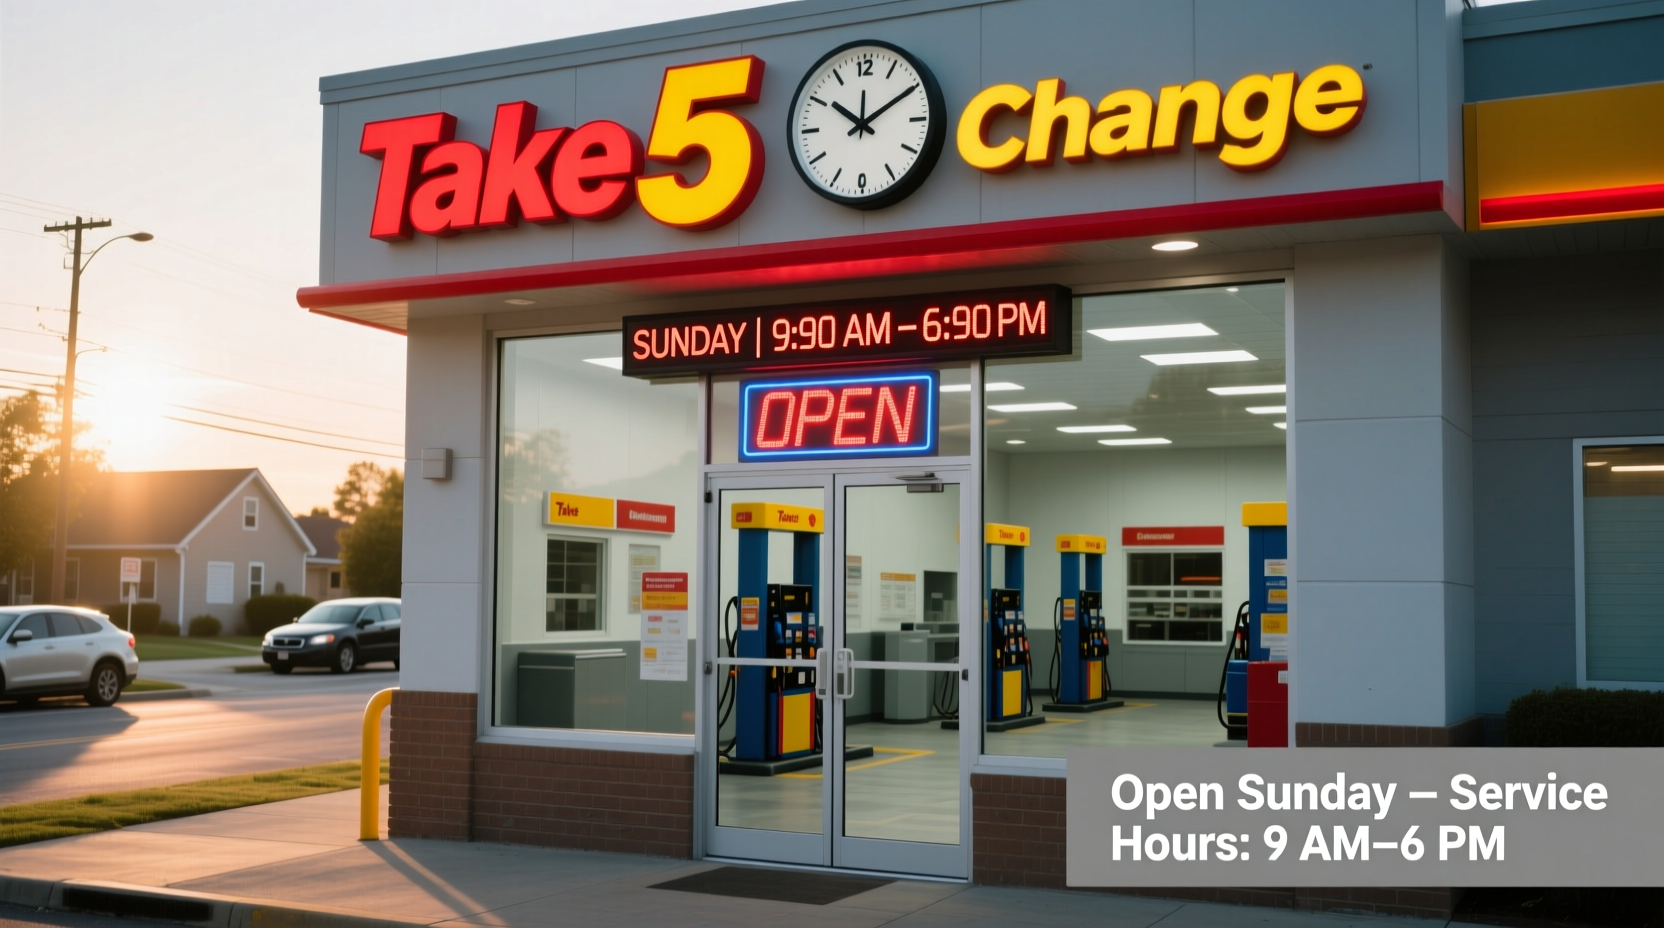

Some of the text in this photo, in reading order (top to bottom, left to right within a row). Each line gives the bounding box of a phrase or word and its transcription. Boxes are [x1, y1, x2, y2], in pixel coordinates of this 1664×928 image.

[856, 58, 874, 78] 12
[360, 55, 1367, 242] Take 5 Change
[632, 321, 747, 361] SUNDAY
[772, 314, 836, 352] 9:90
[842, 311, 891, 348] AM
[922, 303, 992, 343] 6:90
[997, 300, 1046, 338] PM
[756, 386, 916, 448] OPEN
